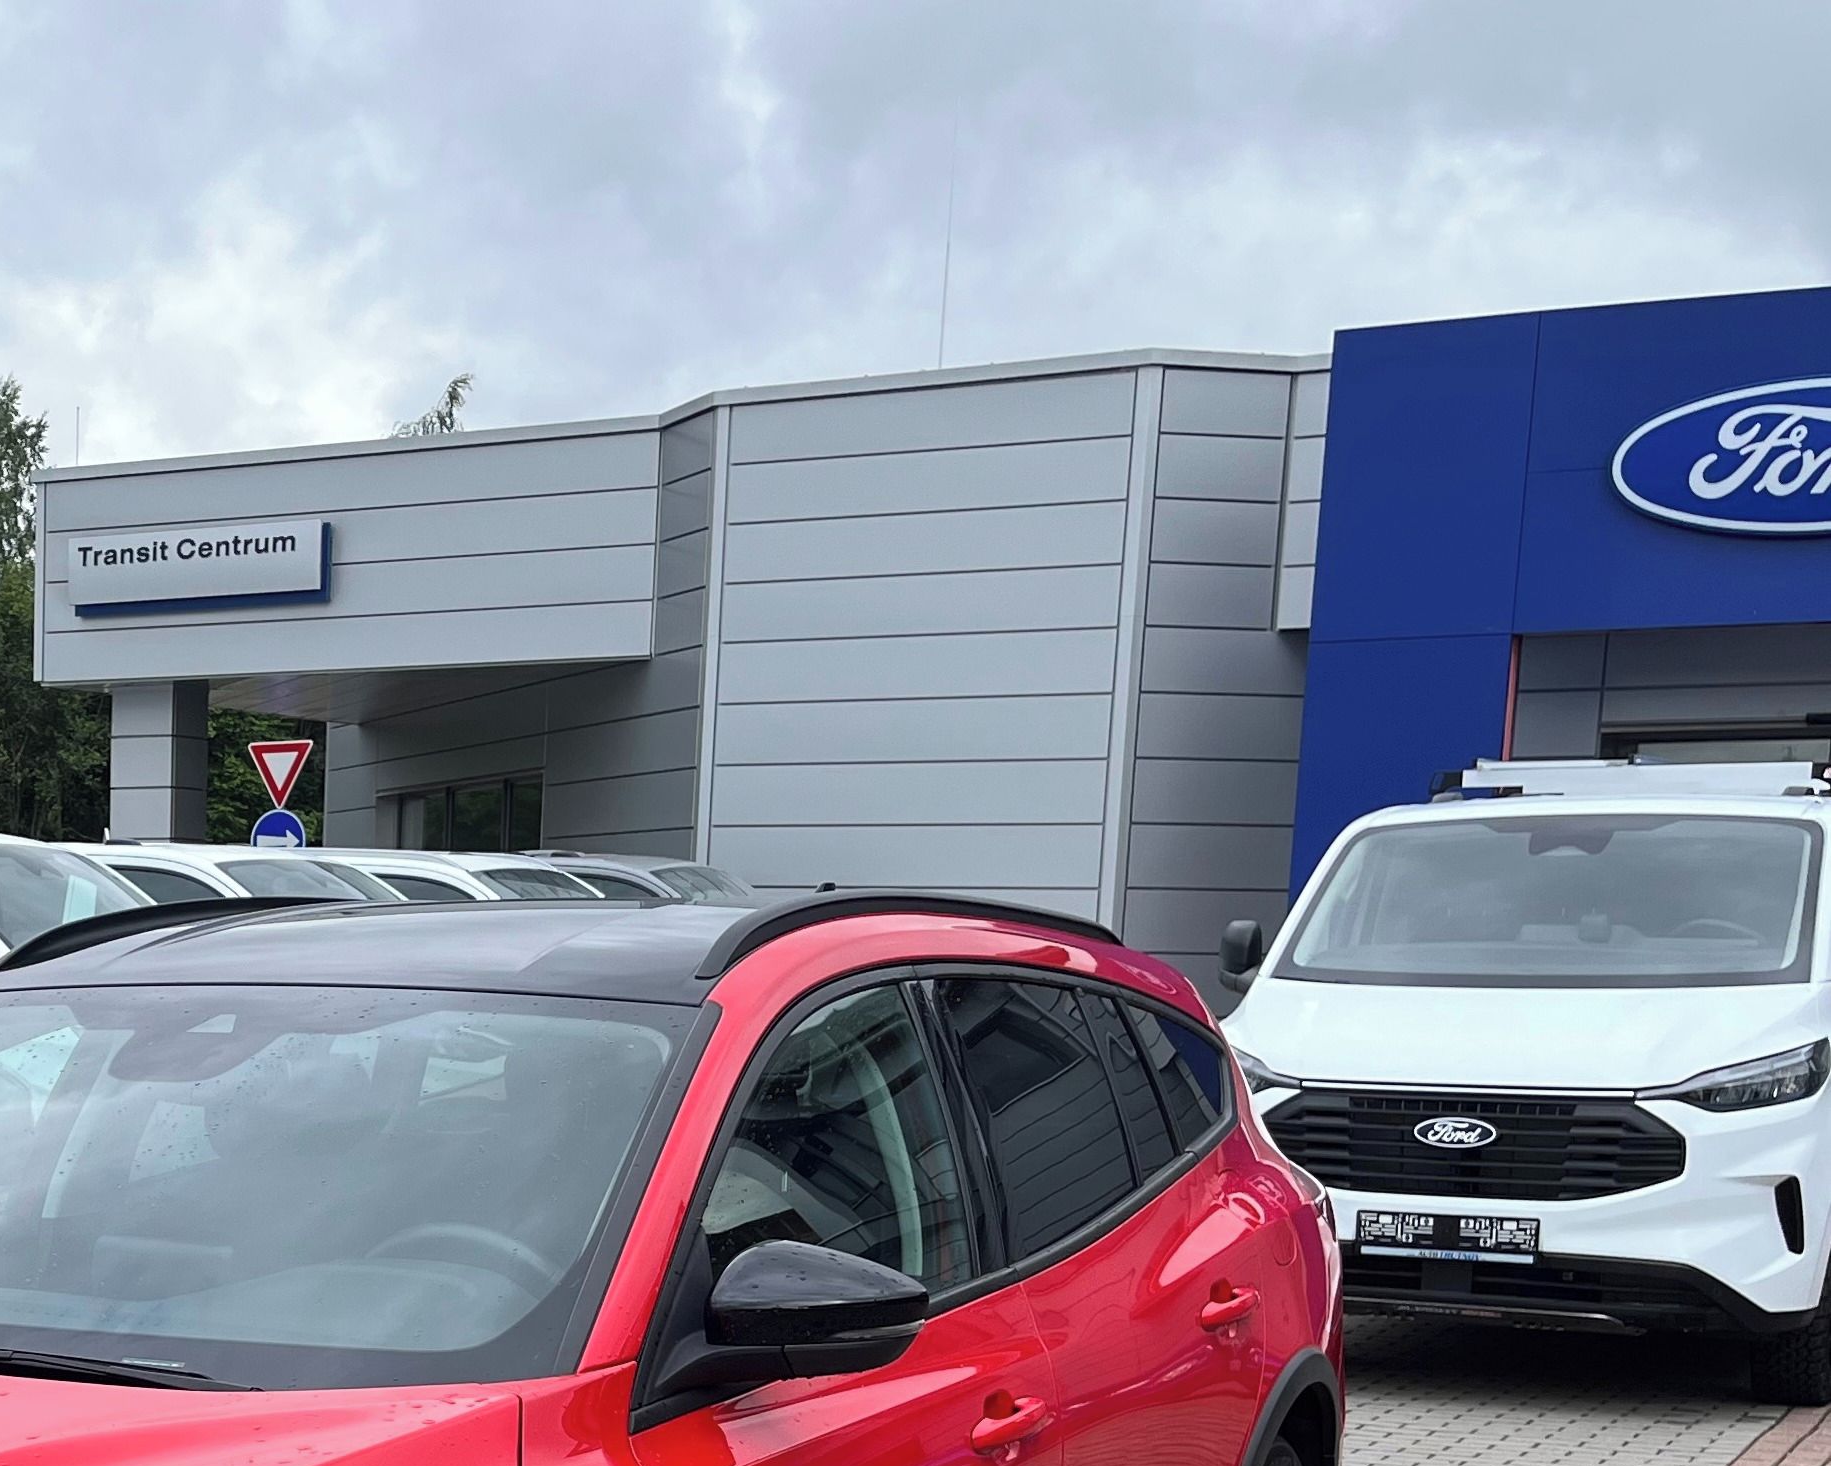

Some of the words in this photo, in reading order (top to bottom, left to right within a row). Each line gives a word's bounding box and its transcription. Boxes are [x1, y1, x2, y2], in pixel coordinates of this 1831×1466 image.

[1688, 403, 1831, 500] Fo
[78, 540, 168, 567] Transit
[176, 534, 297, 560] Centrum
[1426, 1119, 1482, 1145] Ford
